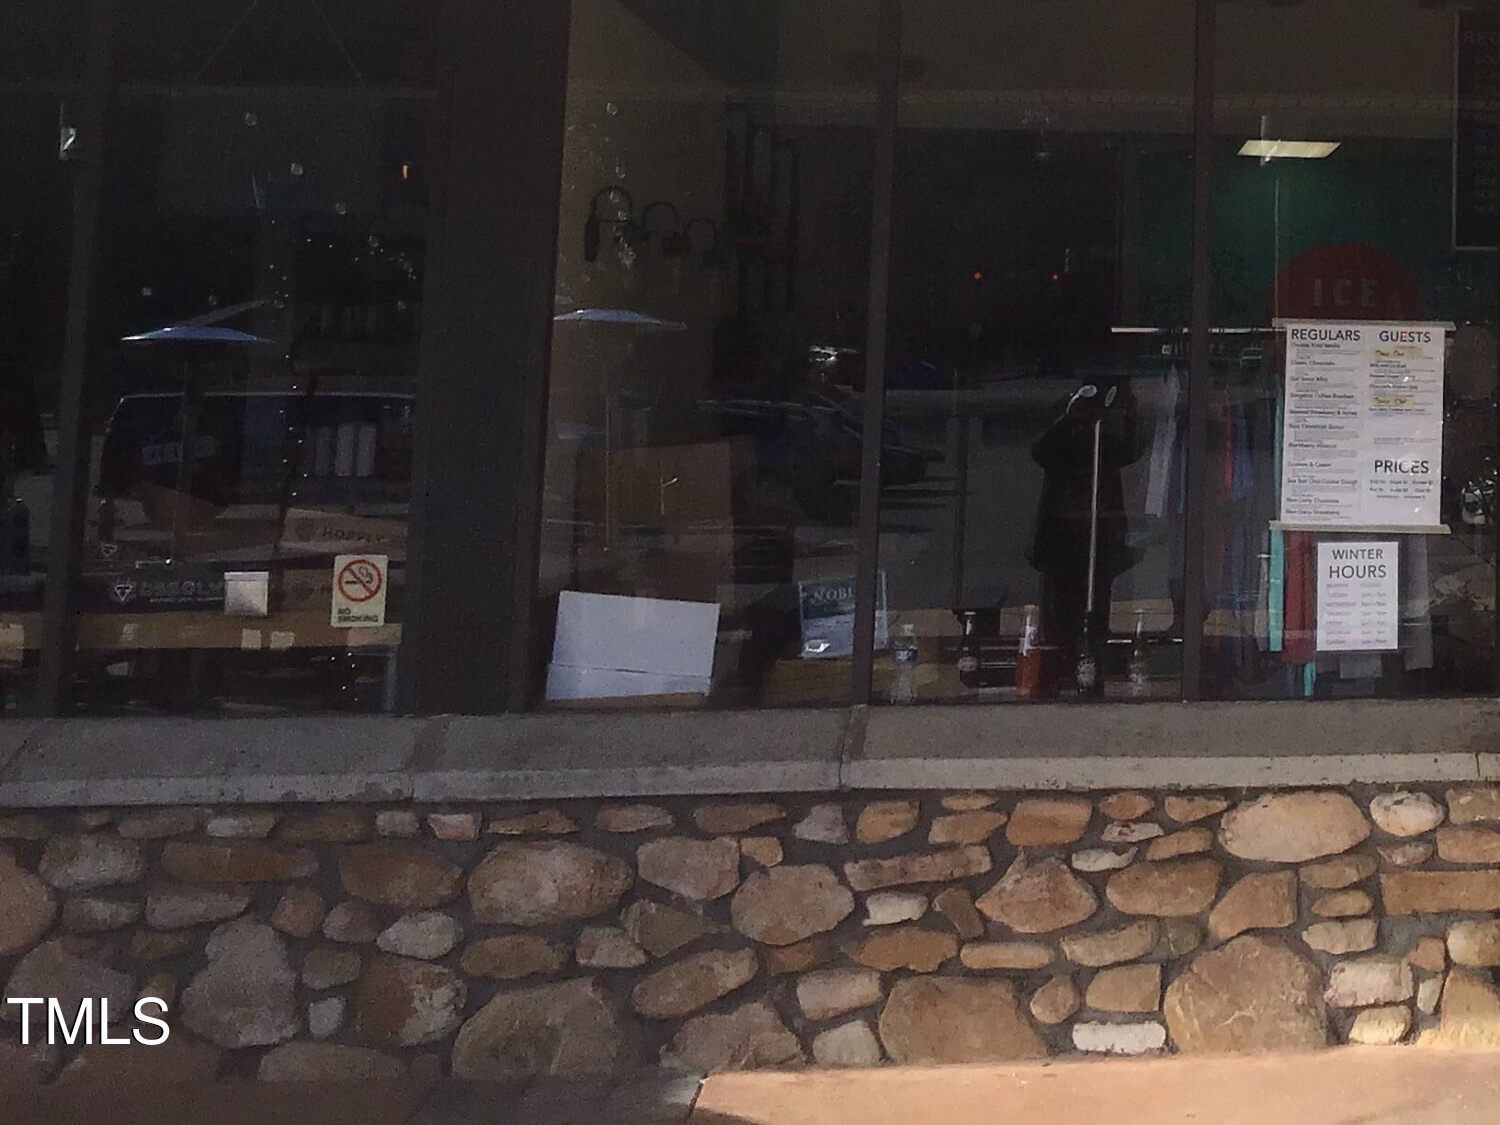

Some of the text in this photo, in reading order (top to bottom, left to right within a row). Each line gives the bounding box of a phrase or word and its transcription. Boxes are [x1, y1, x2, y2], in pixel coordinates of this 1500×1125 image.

[1314, 277, 1377, 307] ICE
[1291, 328, 1361, 341] REGULARS
[1379, 330, 1431, 343] GUESTS
[1374, 459, 1429, 474] PRICES
[1332, 549, 1383, 560] WINTER
[1329, 565, 1387, 579] HOURS
